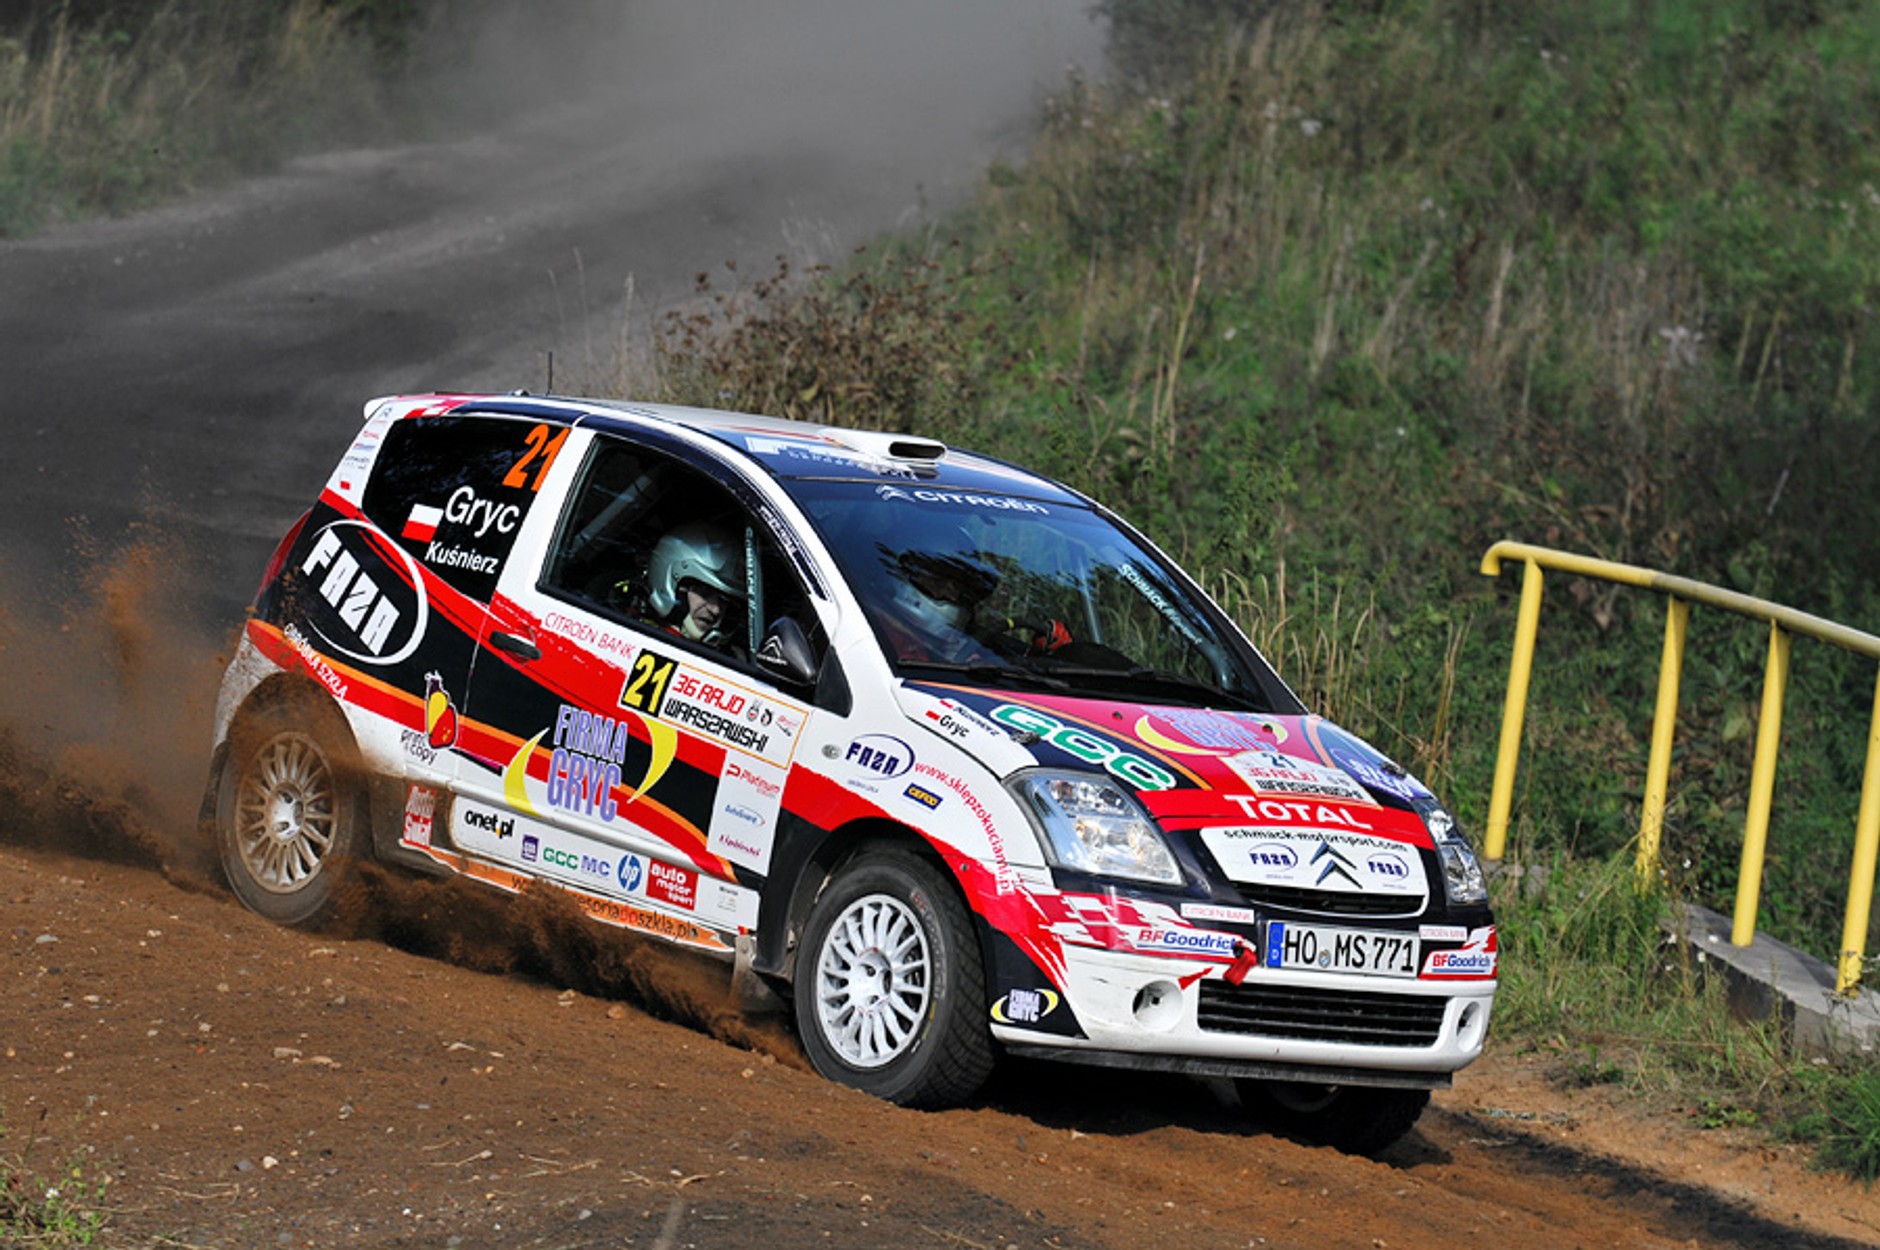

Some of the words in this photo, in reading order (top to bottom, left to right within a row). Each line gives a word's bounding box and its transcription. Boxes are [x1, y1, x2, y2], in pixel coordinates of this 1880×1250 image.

[502, 424, 571, 491] 21
[446, 486, 519, 537] Gryc
[425, 541, 499, 573] Kuśnierz
[599, 635, 634, 659] BANK
[622, 654, 674, 714] 21
[672, 673, 701, 697] 36
[554, 704, 628, 763] FIRMA
[940, 715, 970, 737] Gryc
[409, 743, 438, 765] copy
[546, 748, 622, 823] GRYC
[464, 810, 514, 839] onet.pl
[1223, 795, 1374, 830] TOTAL
[542, 847, 578, 870] GCC
[581, 855, 611, 876] MC
[620, 855, 640, 890] hp
[651, 863, 687, 885] auto
[1283, 930, 1317, 966] HO
[1335, 934, 1367, 969] MS
[1373, 937, 1414, 972] 771
[1433, 953, 1491, 967] BFGoodrich
